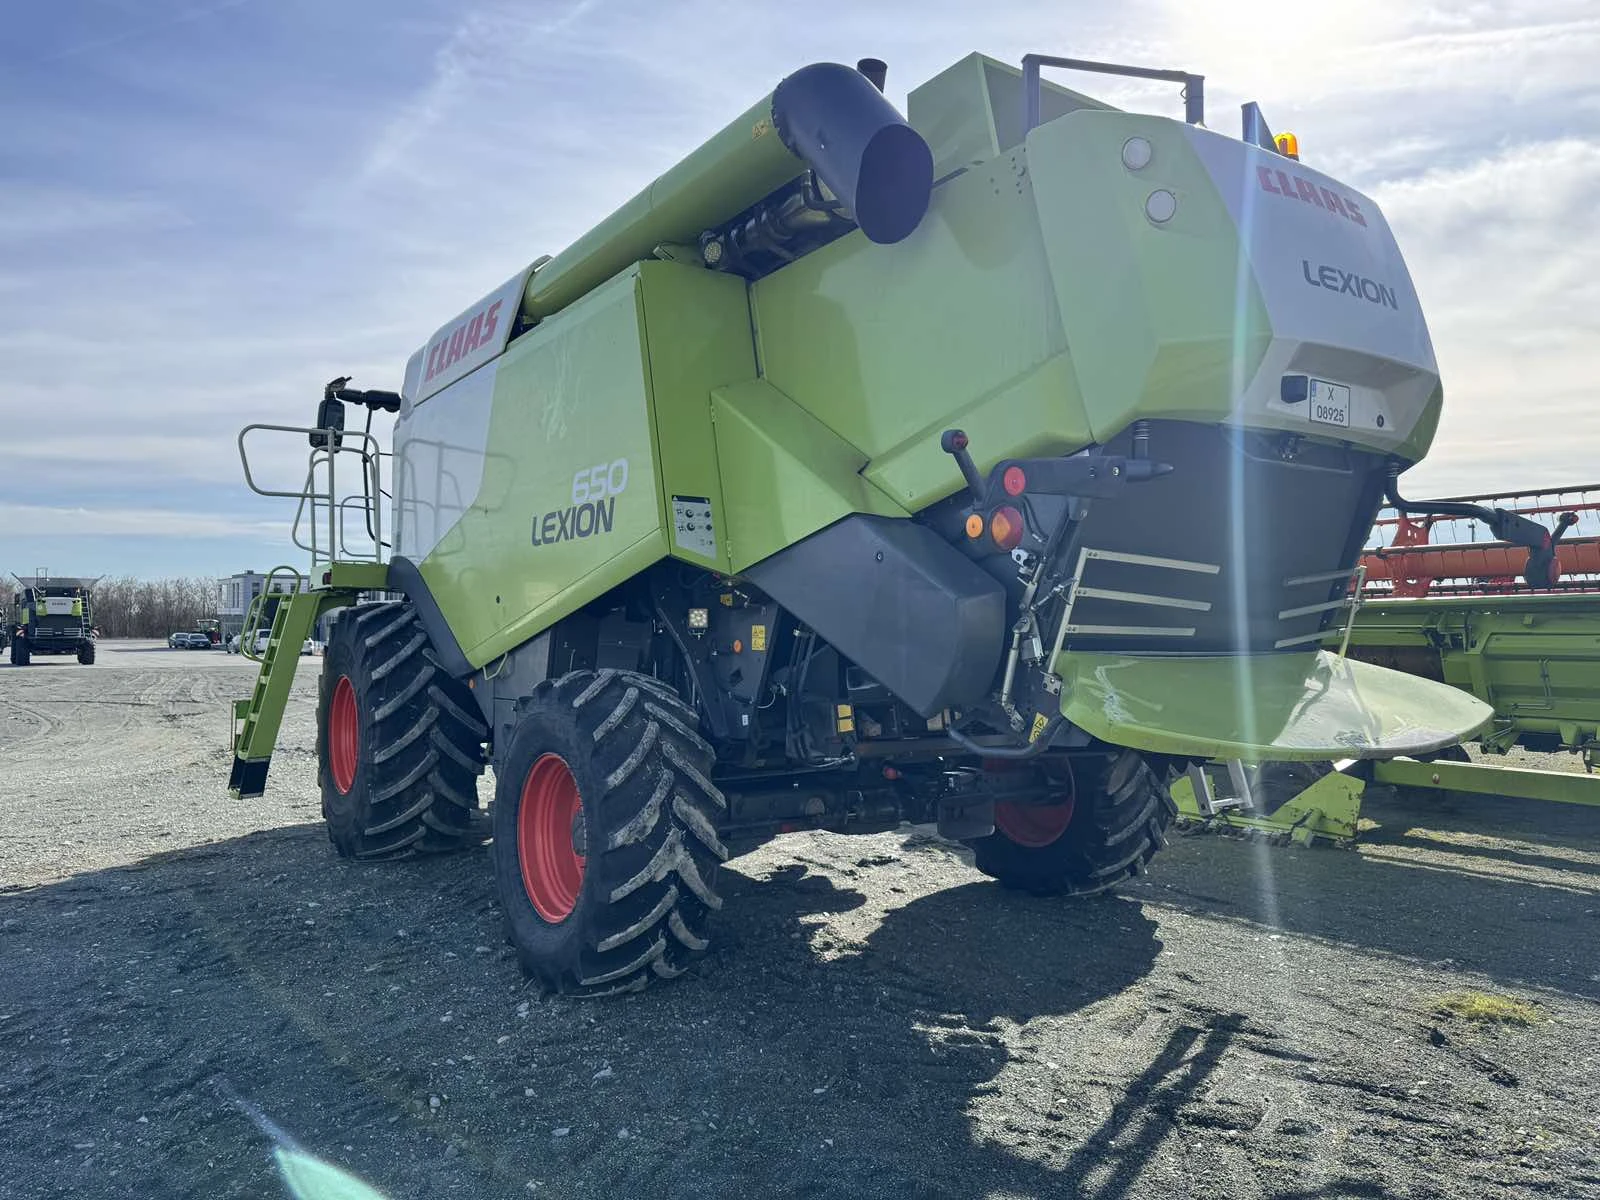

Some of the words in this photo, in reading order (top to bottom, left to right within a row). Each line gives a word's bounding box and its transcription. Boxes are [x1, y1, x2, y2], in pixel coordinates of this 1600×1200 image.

[1257, 166, 1367, 227] CLAAS
[1303, 260, 1398, 310] LEXION
[426, 300, 502, 382] CLAAS
[1317, 405, 1344, 423] 08925
[571, 457, 629, 504] 650
[531, 497, 616, 546] LEXION
